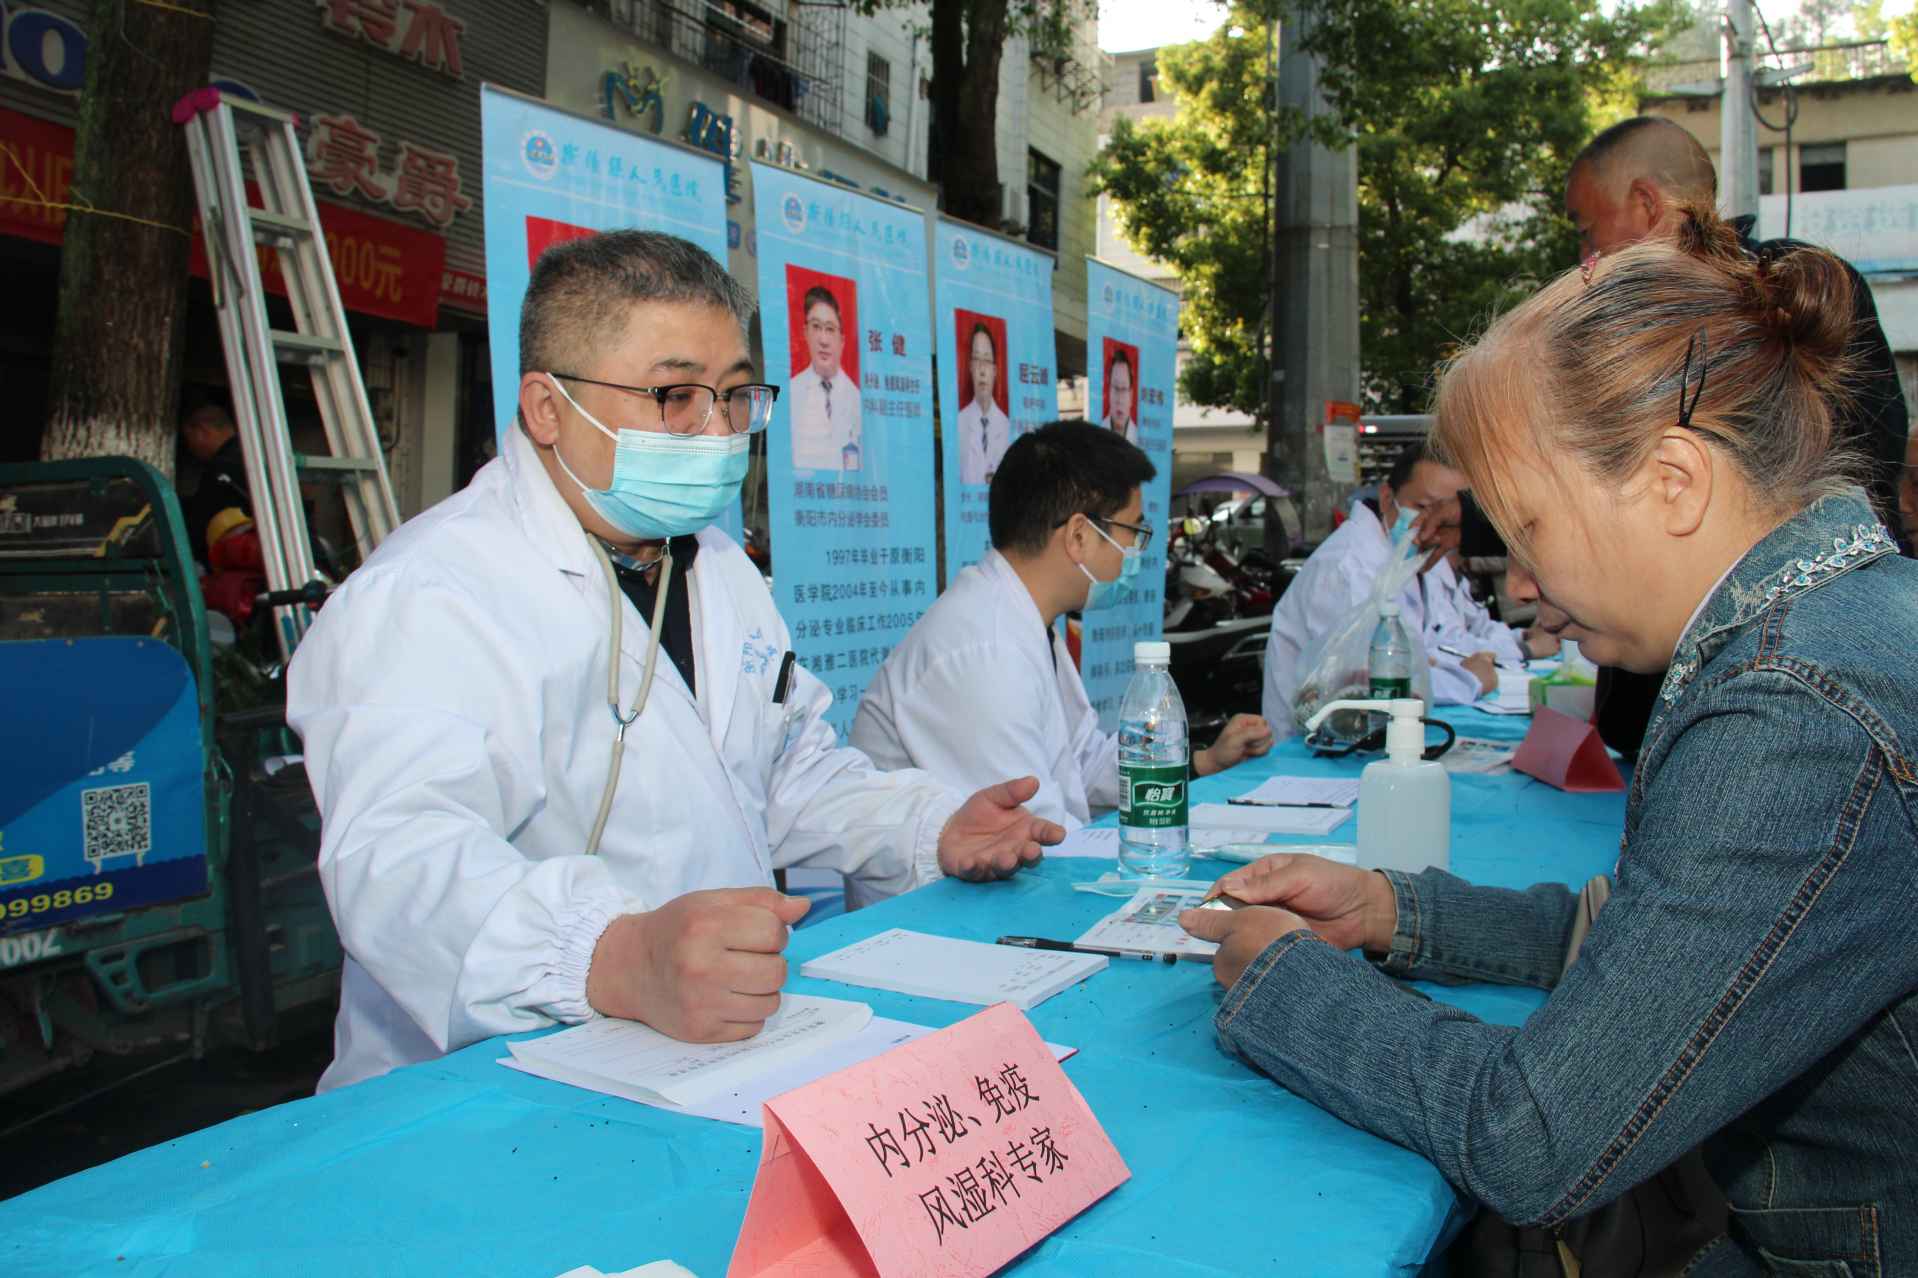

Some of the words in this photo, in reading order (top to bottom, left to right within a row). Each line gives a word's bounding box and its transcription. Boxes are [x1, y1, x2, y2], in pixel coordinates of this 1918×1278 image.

[309, 115, 473, 227] 豪爵
[327, 232, 403, 302] 00元
[865, 1063, 1040, 1178] 内分泌、免疫
[919, 1127, 1069, 1246] 风湿科专家
